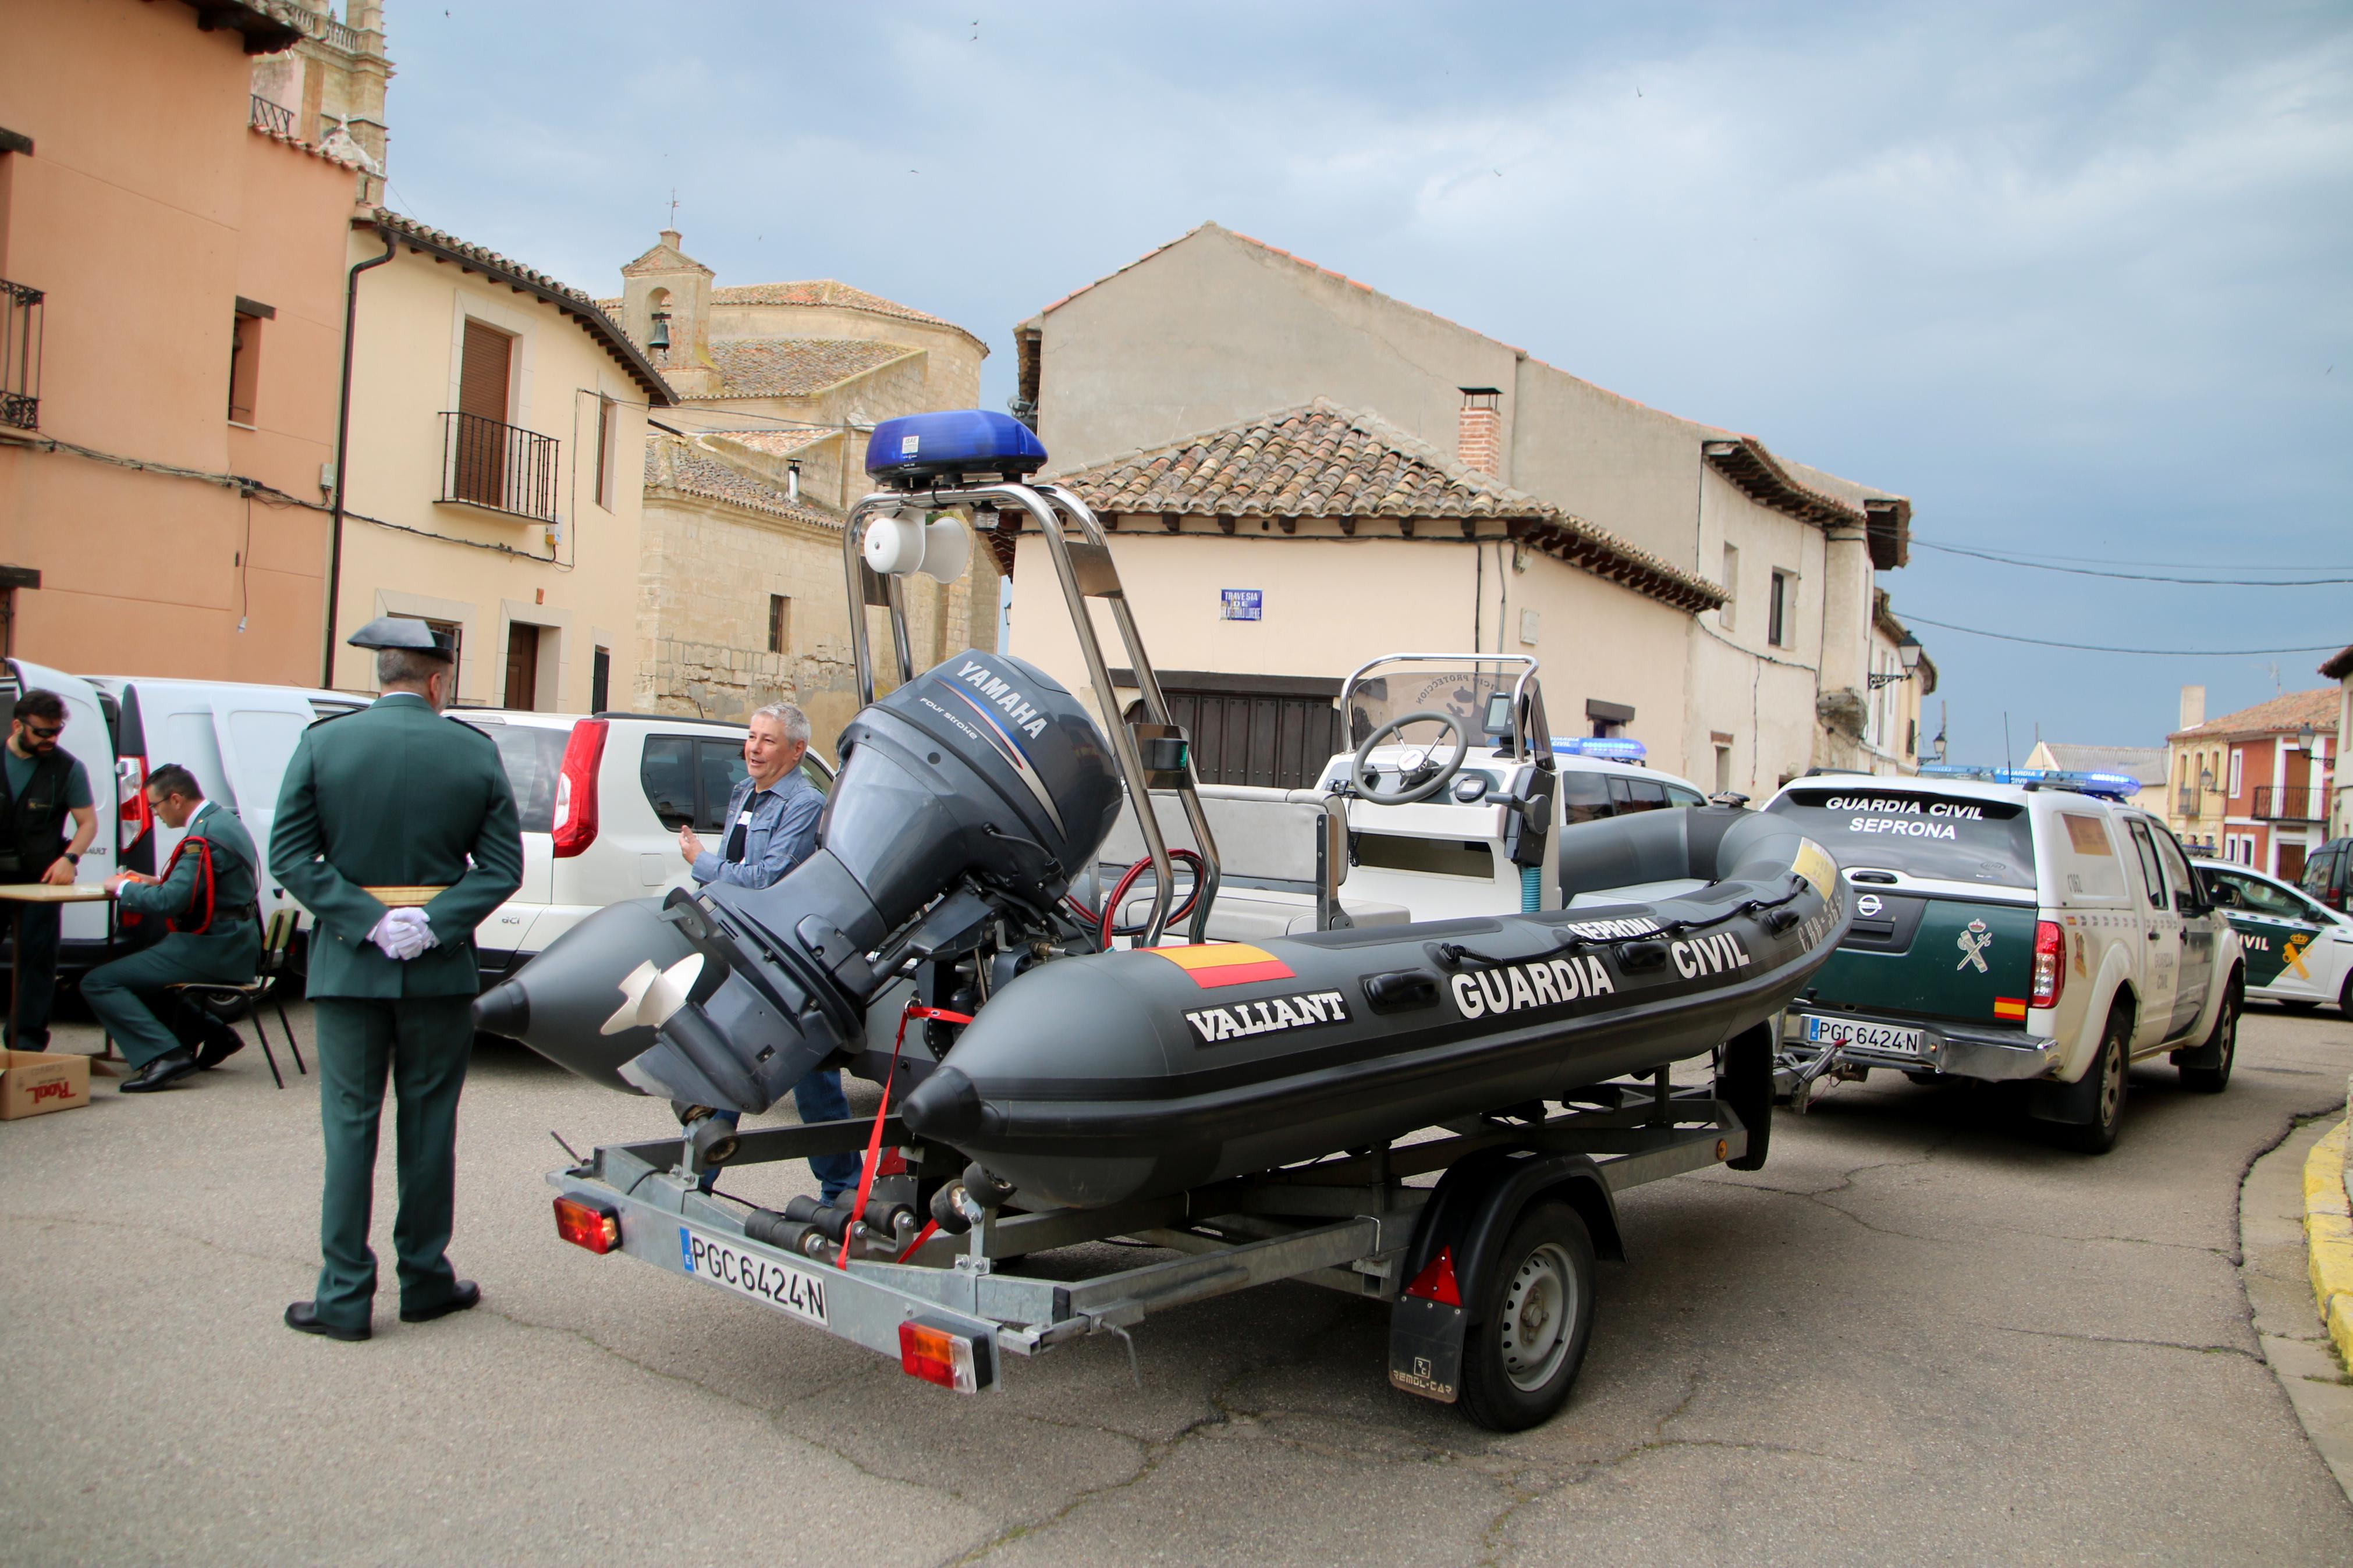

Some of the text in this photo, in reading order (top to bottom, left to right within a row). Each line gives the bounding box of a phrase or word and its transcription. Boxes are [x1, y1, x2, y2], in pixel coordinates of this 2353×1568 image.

[1225, 592, 1258, 601] TRAVESIA
[957, 661, 1047, 739] YAMAHA
[1826, 797, 1983, 821] GUARDIA CIVIL
[1849, 817, 1956, 840] SEPRONA
[1567, 918, 1669, 941] SEPRONA
[2239, 934, 2269, 951] IVIL
[1451, 932, 1750, 1019] GUARDIA CIVIL
[1186, 992, 1346, 1042] VALIANT
[685, 1254, 691, 1265] E
